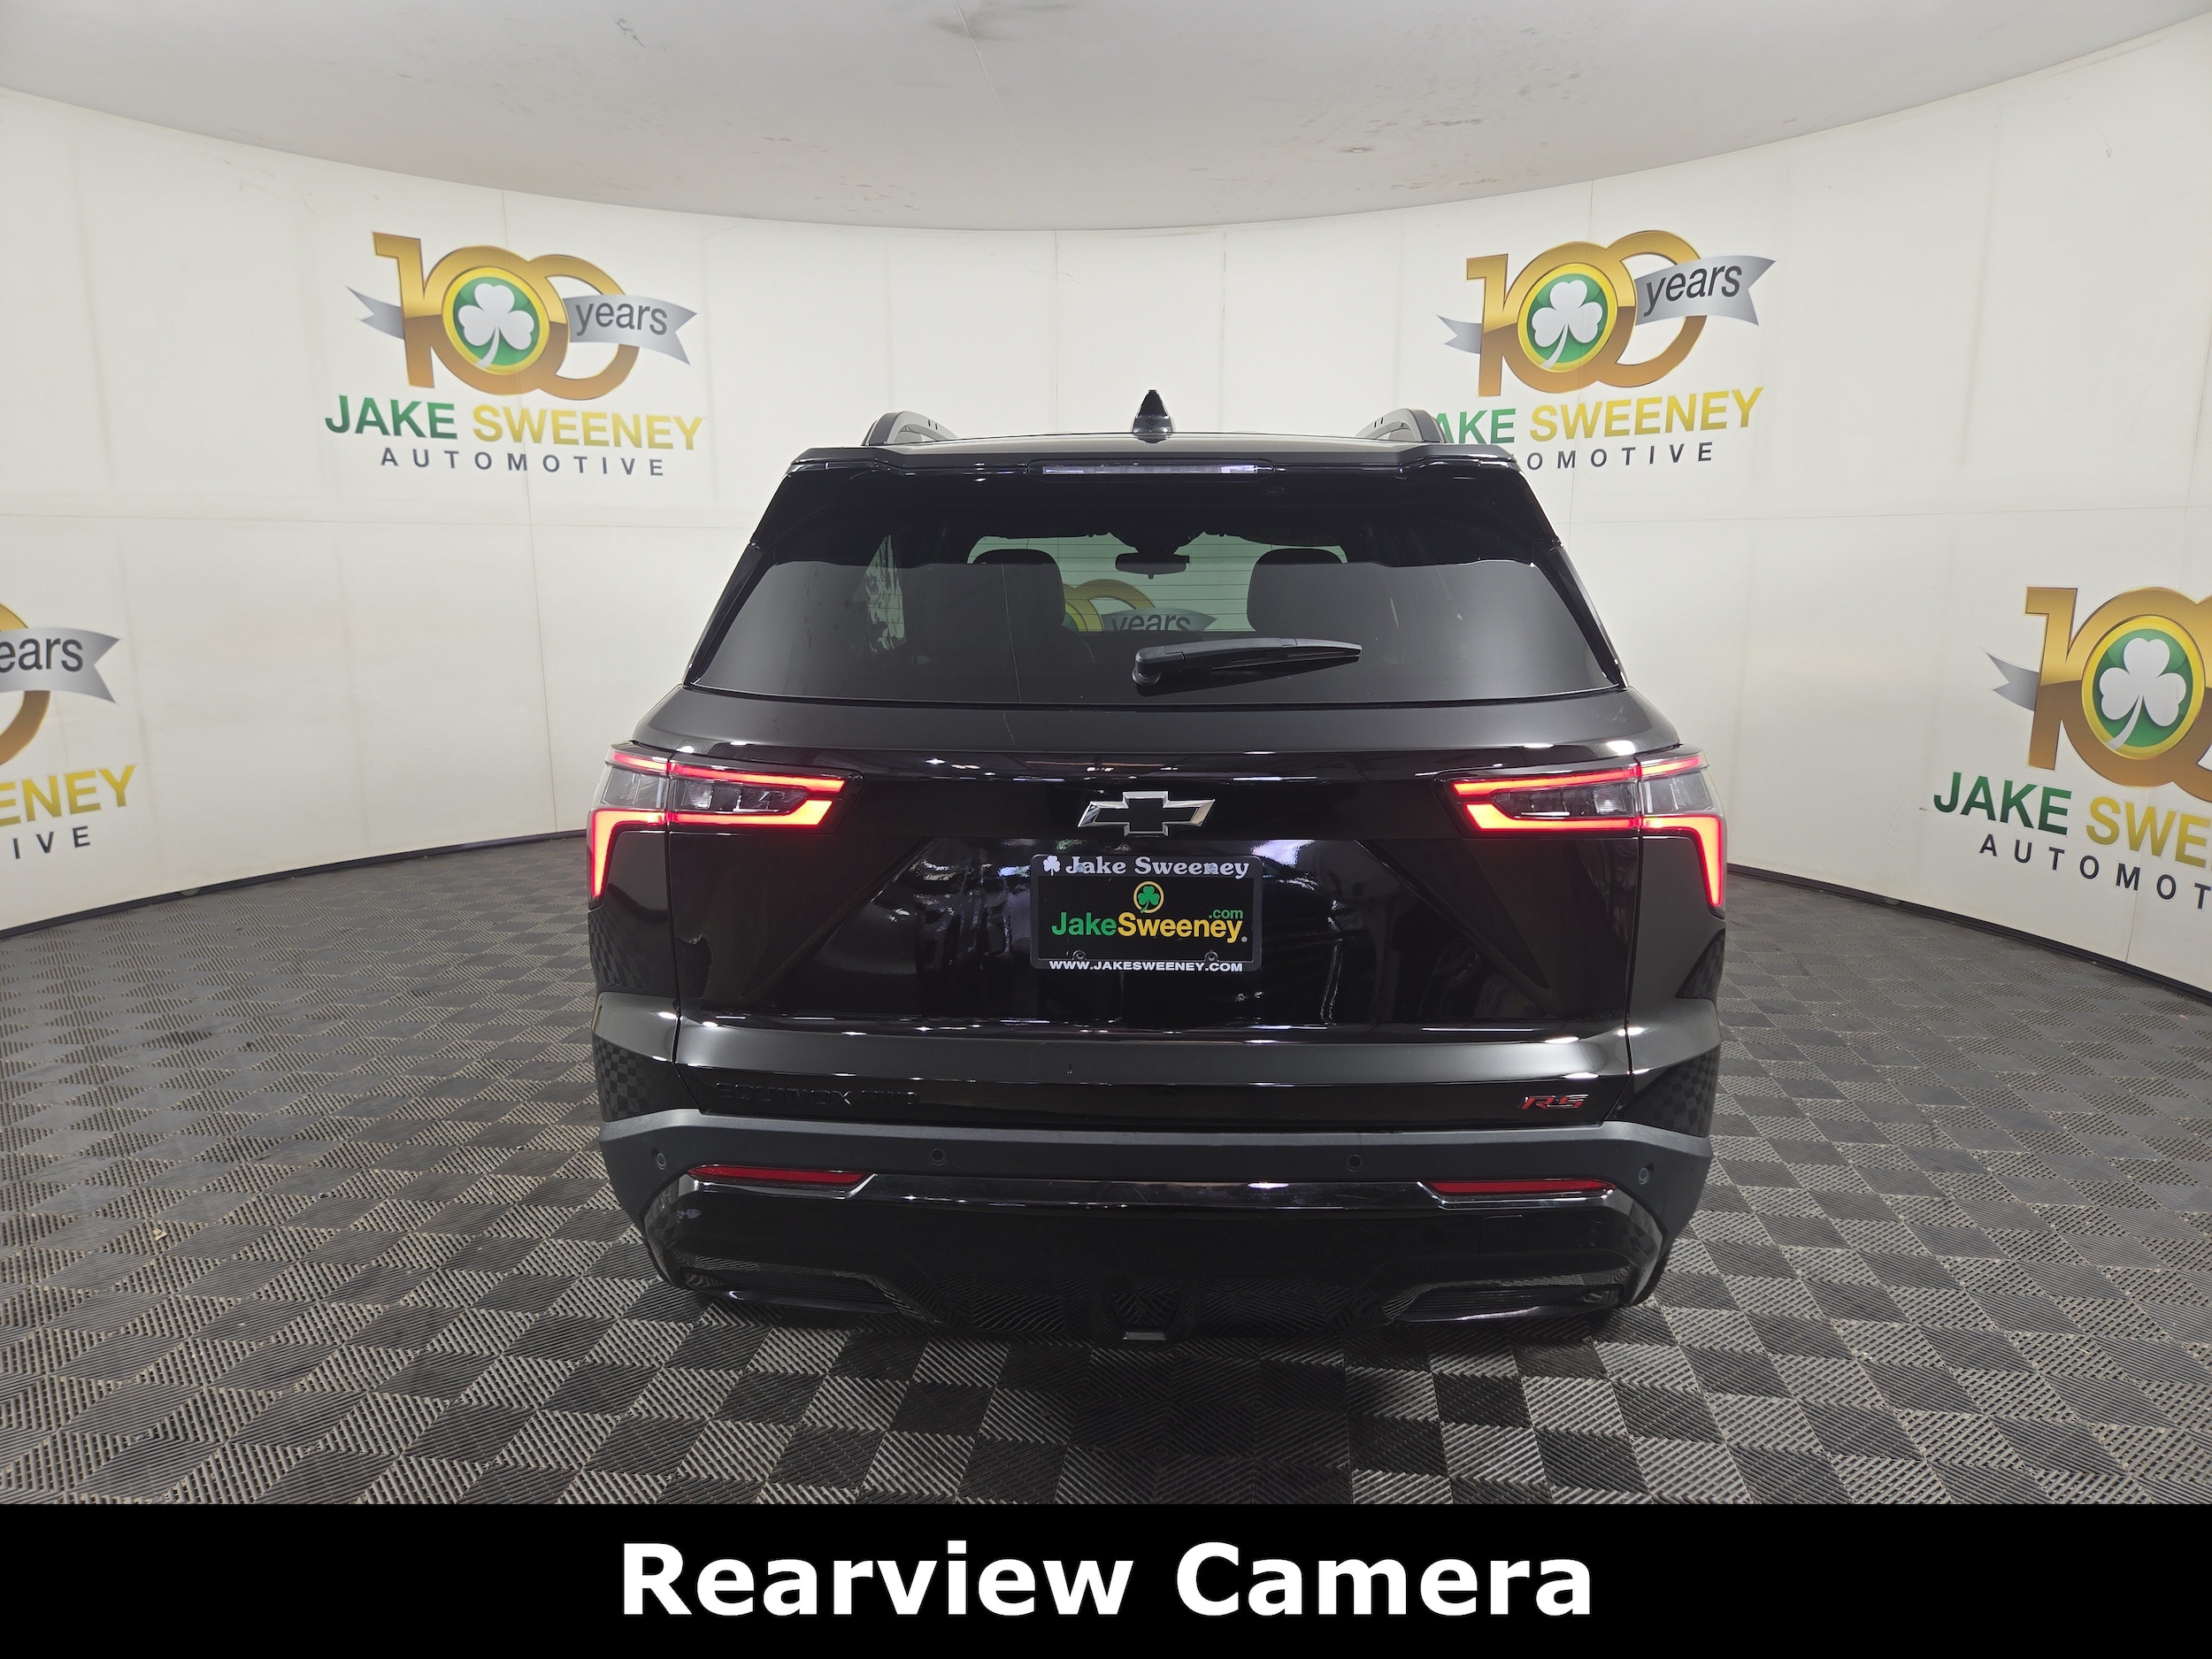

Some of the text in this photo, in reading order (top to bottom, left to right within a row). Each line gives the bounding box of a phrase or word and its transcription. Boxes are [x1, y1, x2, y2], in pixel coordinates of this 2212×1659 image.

[373, 231, 668, 401] 100 years
[1465, 230, 1742, 396] 100 years
[325, 395, 704, 450] JAKE SWEENEY
[1434, 387, 1764, 444] AKE SWEENEY
[380, 447, 664, 477] AUTOMOTIVE
[1526, 442, 1713, 471] OMOTIVE
[2025, 586, 2212, 803] 10
[1933, 772, 2212, 872] JAKE SWE
[1064, 856, 1249, 879] Jake Sweeney
[1208, 908, 1244, 919] .com
[1049, 960, 1243, 972] WWW.JAKESWEENEY.COM
[1521, 1094, 1589, 1110] RS
